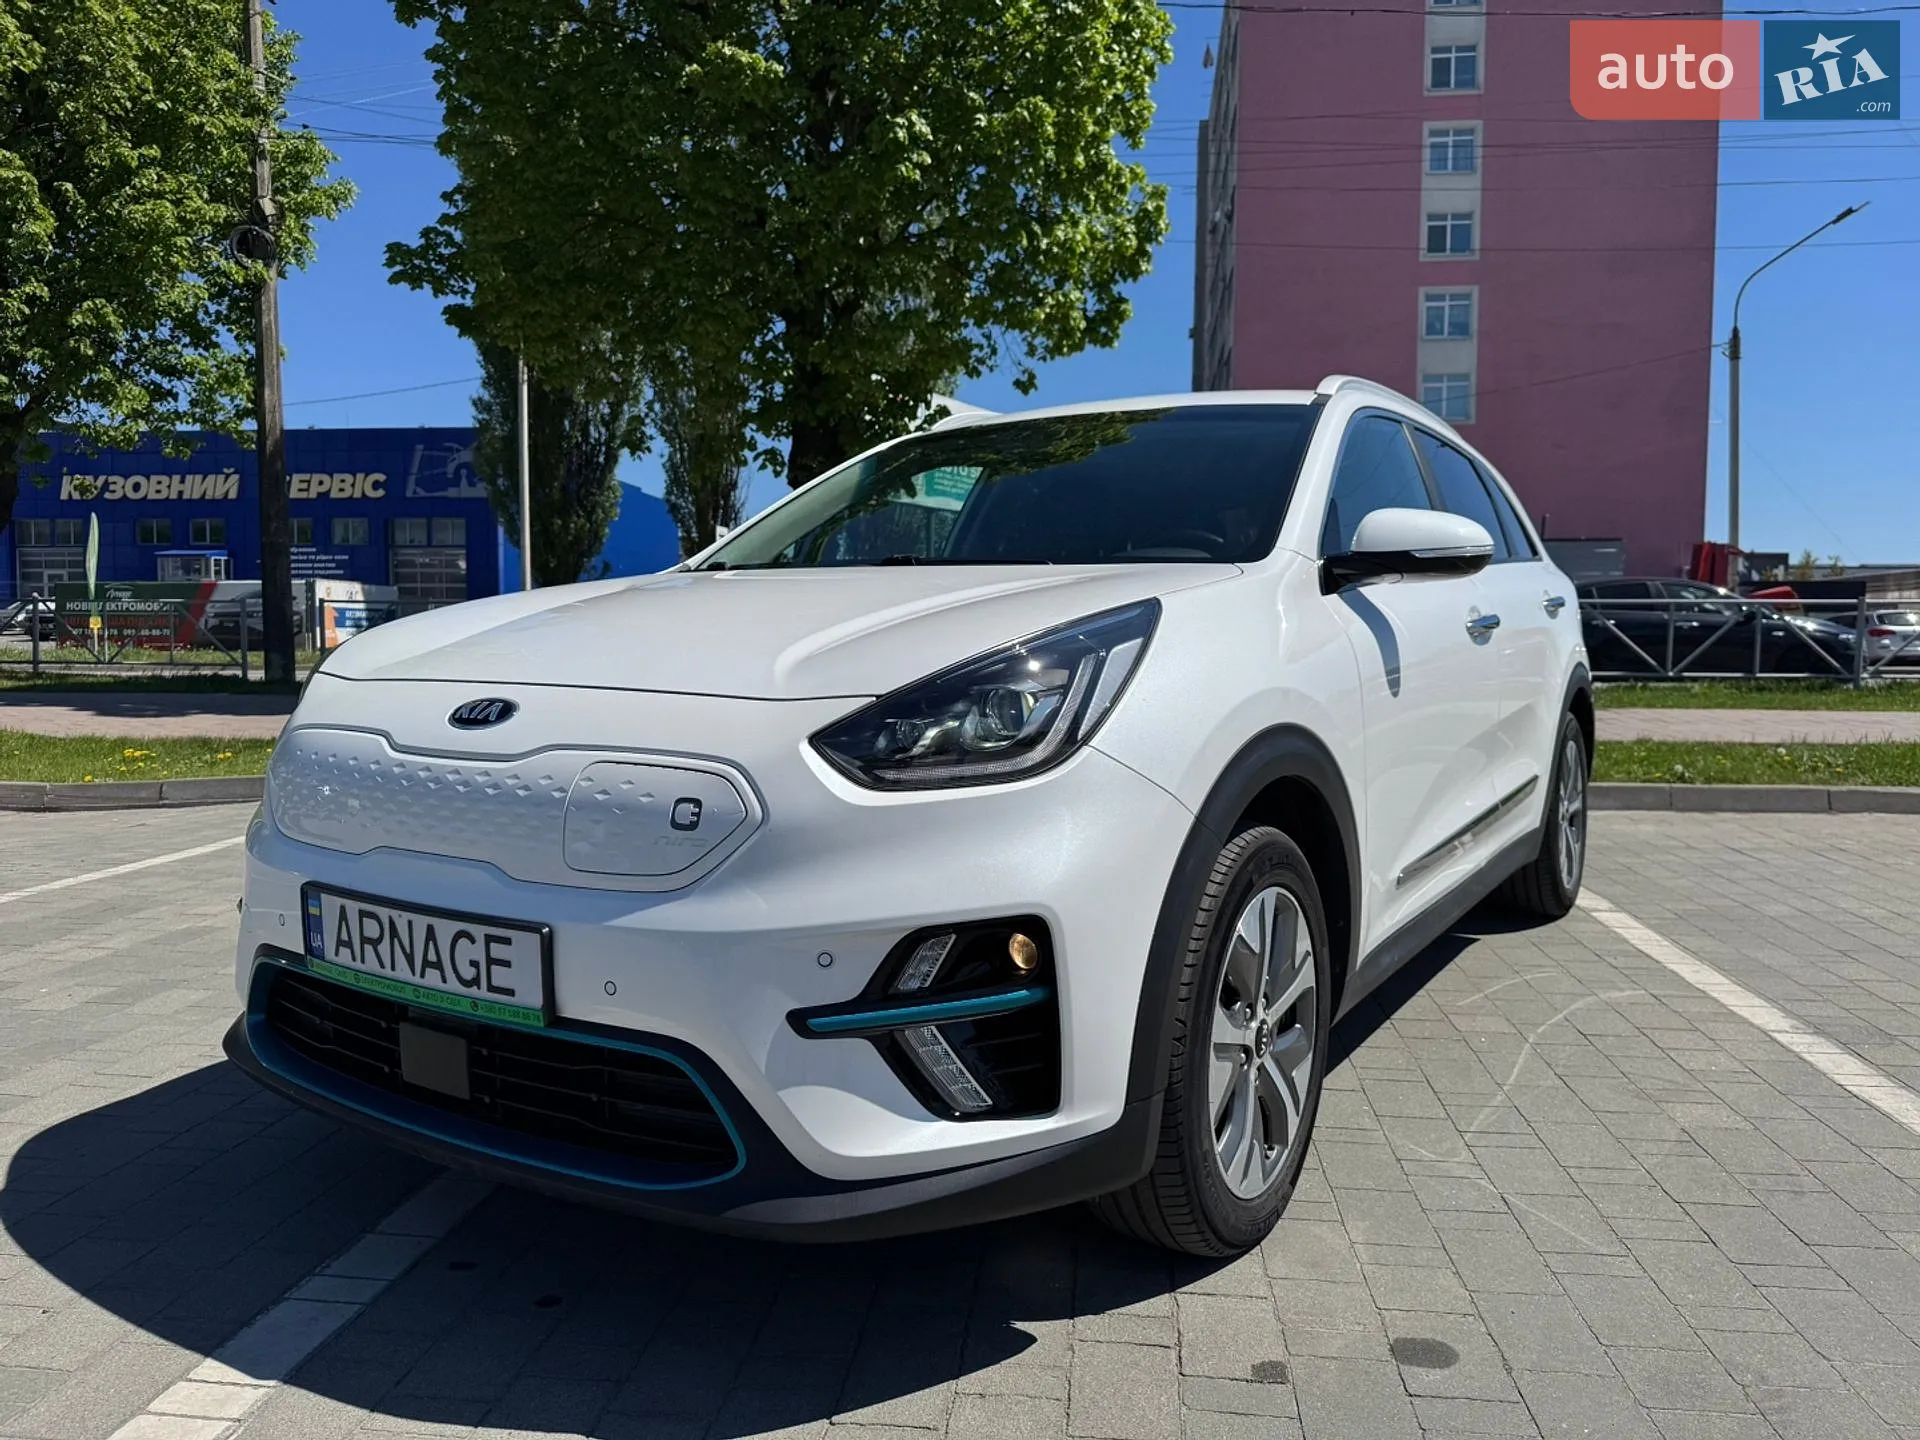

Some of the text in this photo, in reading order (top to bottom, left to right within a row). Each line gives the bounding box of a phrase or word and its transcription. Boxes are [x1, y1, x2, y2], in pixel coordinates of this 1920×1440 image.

[60, 467, 388, 500] КУЗОВНИЙ ЕРВІС
[455, 701, 504, 721] KIA
[310, 932, 323, 948] UA
[334, 904, 516, 998] ARNAGE
